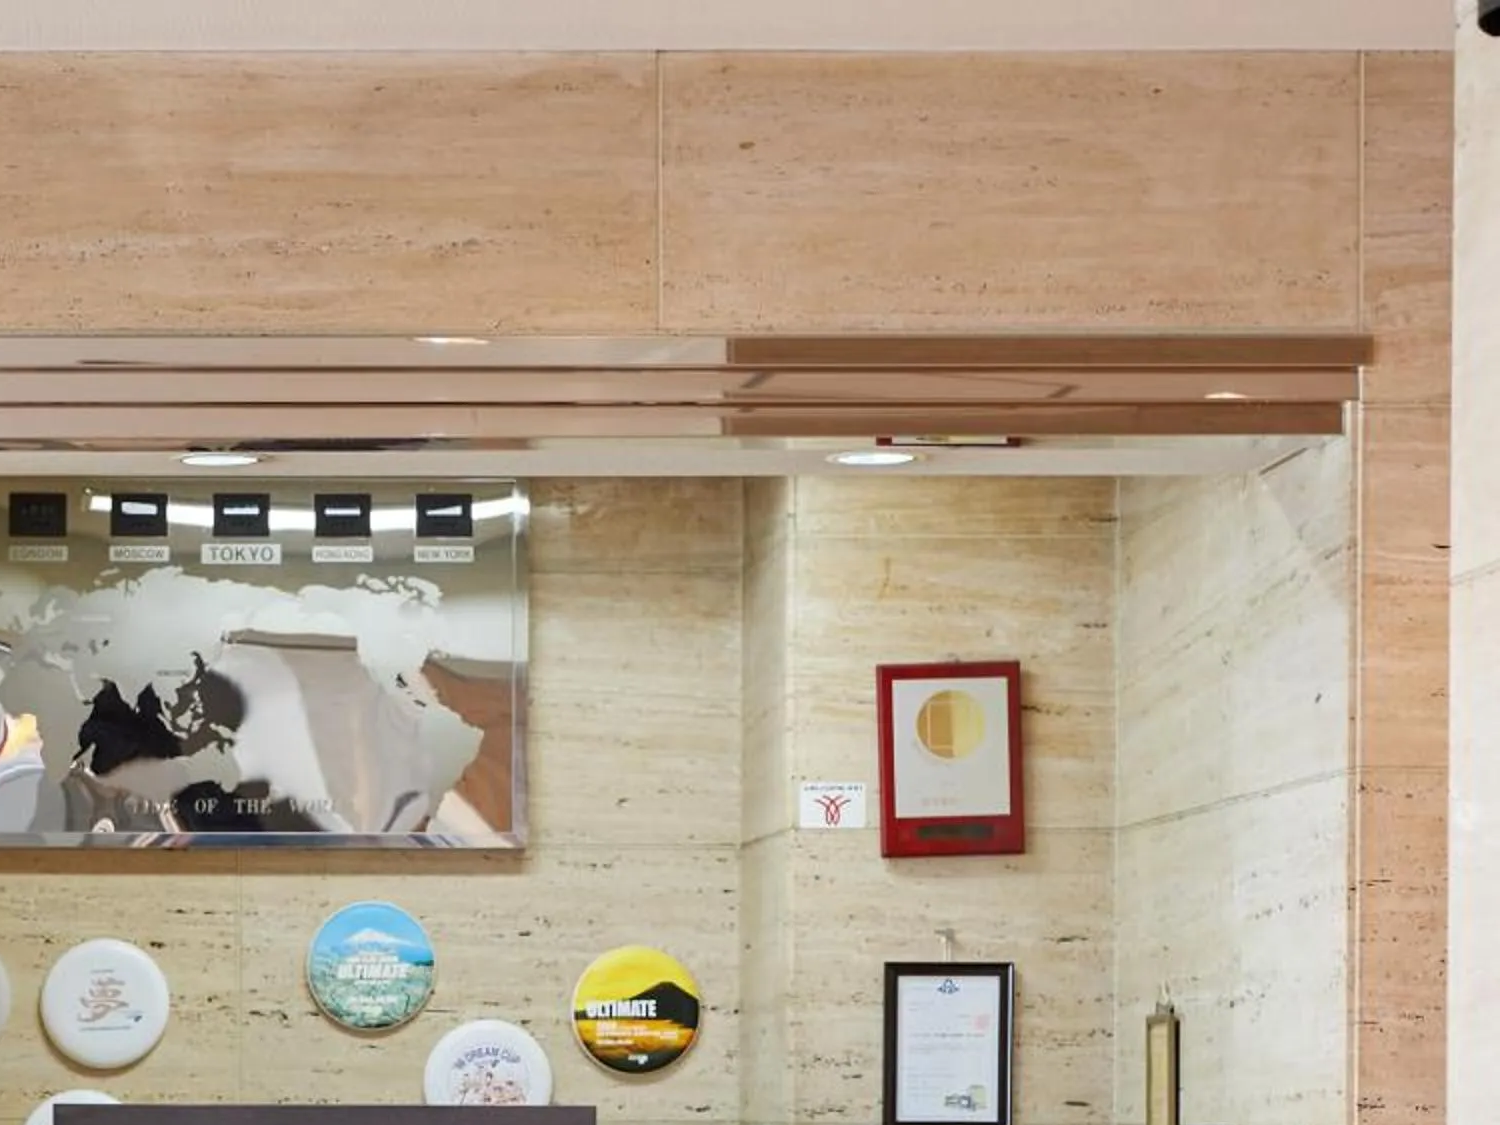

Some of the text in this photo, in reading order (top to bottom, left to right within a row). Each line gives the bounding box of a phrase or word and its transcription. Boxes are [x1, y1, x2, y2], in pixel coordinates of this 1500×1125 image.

[114, 547, 165, 558] MOSCOW
[209, 546, 275, 562] TOKYO
[194, 799, 219, 815] OF
[233, 799, 272, 815] THE
[335, 963, 409, 980] ULTIMATE
[585, 999, 657, 1018] ULTIMATE
